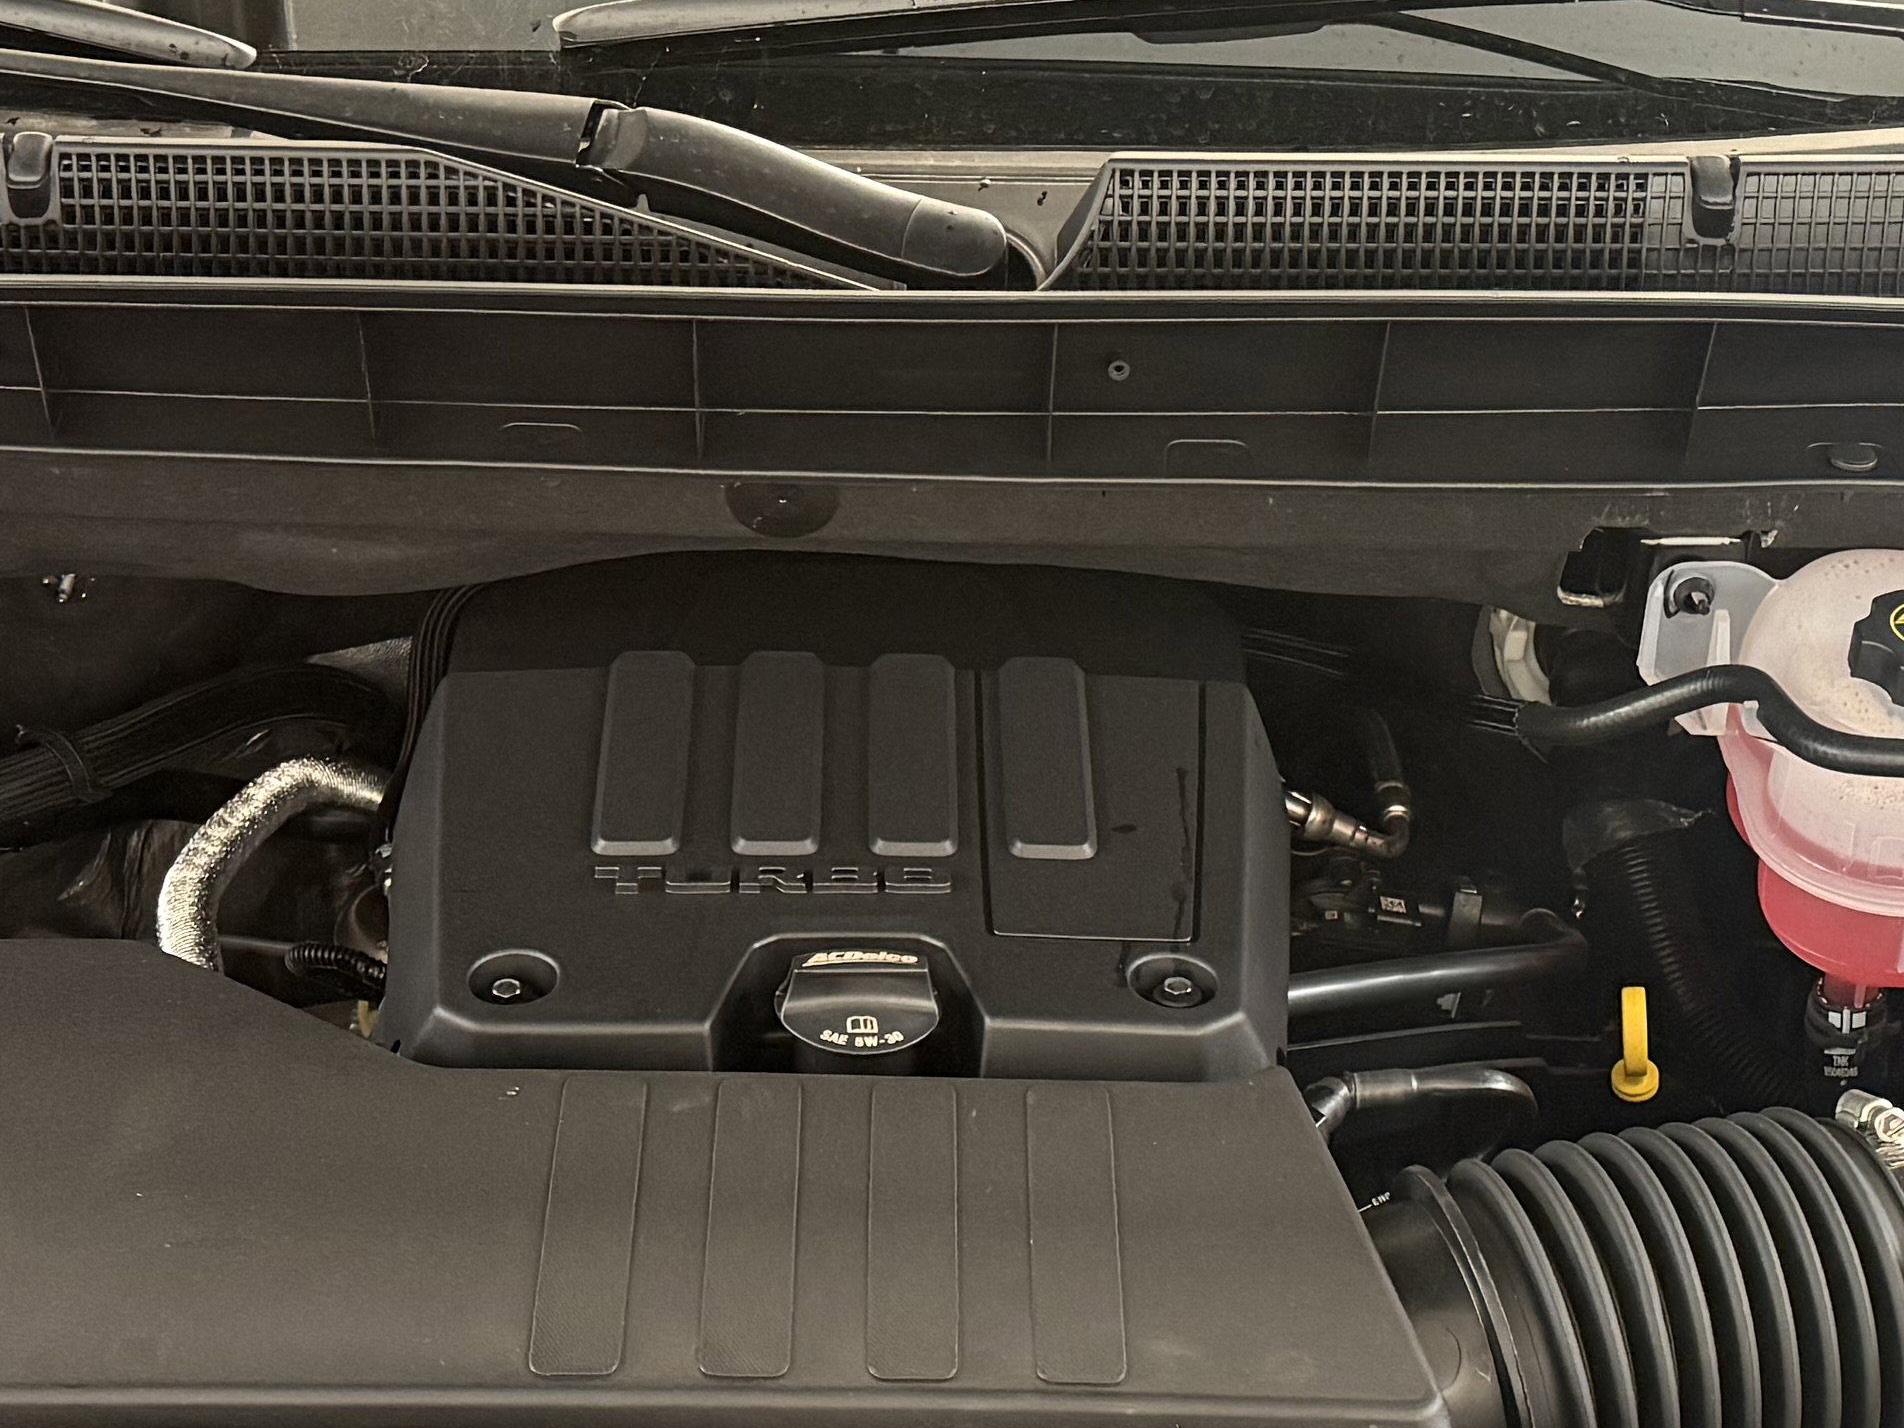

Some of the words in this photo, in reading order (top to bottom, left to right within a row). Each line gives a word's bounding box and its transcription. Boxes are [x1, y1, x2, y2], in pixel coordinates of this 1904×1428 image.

[593, 865, 953, 895] TURBO
[801, 951, 919, 967] ACDelco
[819, 1029, 849, 1046] SAE
[854, 1031, 905, 1048] 5W-30
